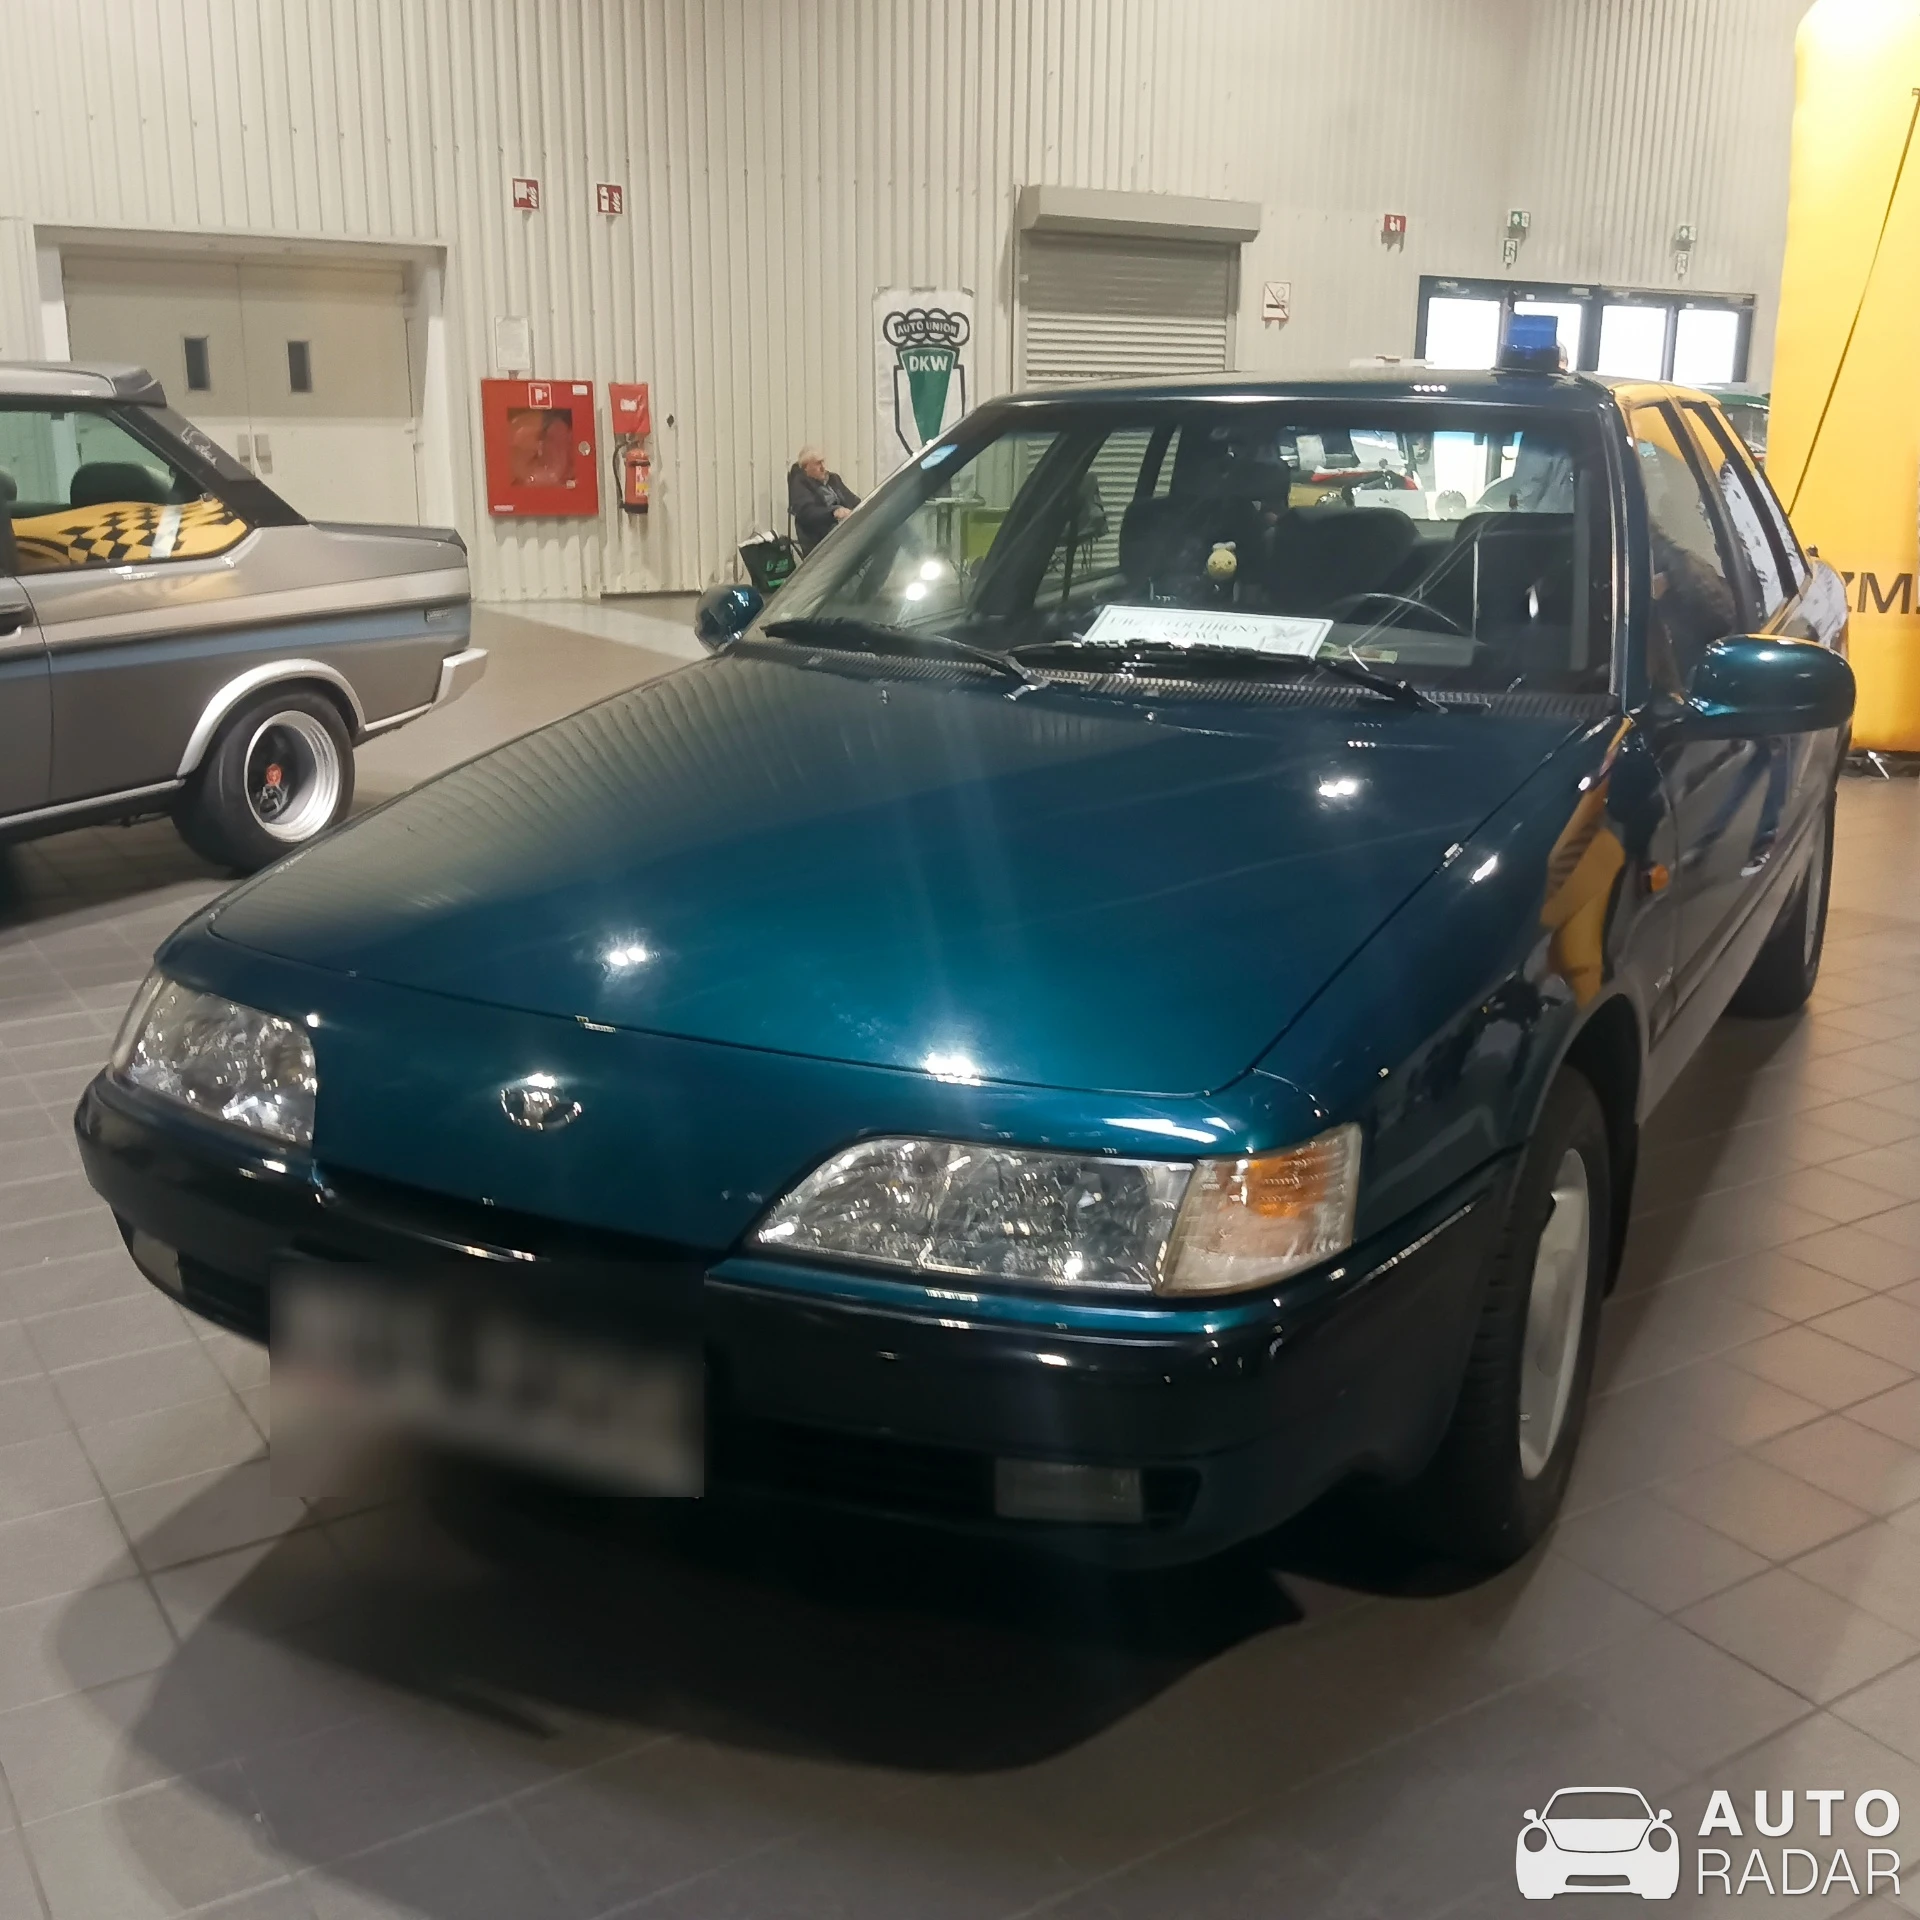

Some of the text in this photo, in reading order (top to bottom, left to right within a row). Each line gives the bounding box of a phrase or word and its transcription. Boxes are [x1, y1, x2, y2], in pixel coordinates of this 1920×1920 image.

[897, 321, 957, 335] AUTO UNION
[909, 355, 949, 372] DKW
